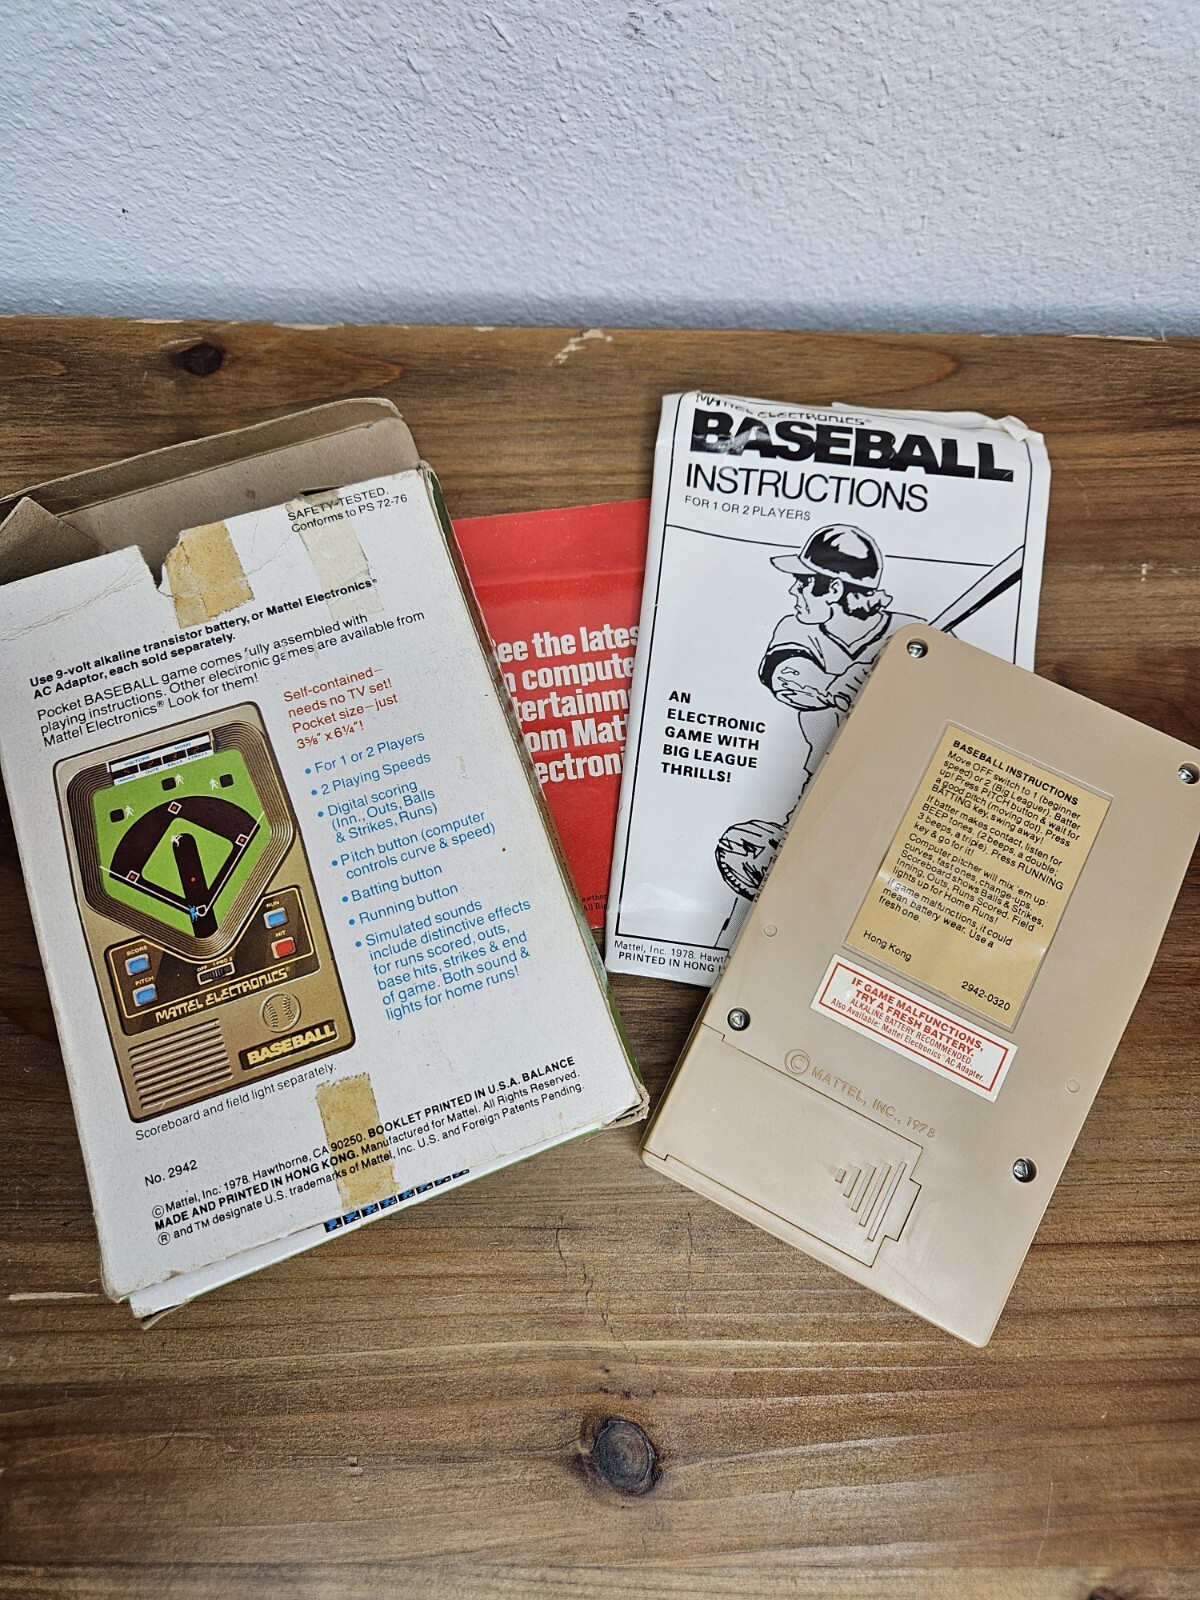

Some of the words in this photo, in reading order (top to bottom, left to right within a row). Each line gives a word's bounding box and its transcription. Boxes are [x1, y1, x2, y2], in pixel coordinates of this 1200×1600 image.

[690, 407, 1014, 482] BASEBALL
[288, 488, 389, 521] SAFETY-TESTED.
[686, 462, 928, 512] INSTRUCTIONS
[291, 512, 344, 532] Conforms
[344, 509, 356, 518] to
[357, 502, 375, 514] PS
[376, 493, 408, 509] 72-76
[684, 495, 709, 508] FOR
[713, 501, 718, 510] 1
[721, 502, 740, 513] OR
[742, 505, 750, 515] 2
[752, 505, 811, 521] PLAYERS
[29, 674, 53, 687] Use
[55, 661, 92, 679] 9-volt
[93, 647, 141, 667] alkaline
[142, 629, 202, 652] transistor
[204, 616, 250, 634] battery,
[251, 611, 263, 620] or
[266, 599, 303, 616] Mattel
[493, 639, 528, 663] ee
[532, 631, 577, 658] the
[33, 685, 52, 699] AC
[55, 671, 107, 693] Adaptor,
[109, 660, 139, 676] each
[141, 650, 168, 666] sold
[170, 633, 236, 657] separately.
[36, 698, 82, 721] Pocket
[83, 675, 159, 706] BASEBALL
[161, 665, 197, 685] game
[200, 652, 242, 671] comes
[342, 613, 368, 628] with
[43, 725, 83, 747] Mattel
[167, 690, 200, 708] Look
[201, 685, 219, 698] for
[221, 672, 258, 692] them!
[288, 699, 327, 718] needs
[329, 694, 346, 706] no
[346, 685, 365, 699] TV
[368, 677, 392, 694] set!
[512, 688, 631, 722] tertainm
[668, 690, 691, 704] AN
[292, 712, 337, 733] Pocket
[664, 725, 713, 743] GAME
[717, 734, 759, 750] WITH
[667, 707, 766, 733] ELECTRONIC
[314, 759, 336, 773] For
[340, 755, 346, 765] 1
[350, 751, 363, 762] or
[365, 746, 375, 758] 2
[376, 732, 425, 754] Players
[535, 746, 626, 784] ectron
[660, 761, 731, 783] THRILLS!
[662, 743, 689, 758] BIG
[693, 748, 758, 768] LEAGUE
[320, 783, 330, 795] 2
[332, 769, 380, 791] Playing
[382, 753, 431, 775] Speeds
[947, 750, 971, 767] Move
[972, 762, 994, 776] OFF
[992, 773, 1020, 791] switch
[1021, 786, 1031, 796] to
[1038, 794, 1081, 820] (beginner
[952, 740, 1003, 770] BASEBALL
[1005, 765, 1078, 805] INSTRUCTIONS
[327, 794, 368, 816] Digital
[370, 781, 418, 803] scoring
[917, 812, 925, 820] 3
[924, 814, 953, 836] beeps,
[990, 848, 1016, 867] Press
[1016, 859, 1064, 891] RUNNING
[350, 879, 399, 902] Batting
[400, 865, 442, 886] button
[358, 899, 415, 924] Running
[415, 884, 458, 905] button
[365, 914, 432, 946] Simulated
[434, 901, 482, 923] sounds
[275, 930, 286, 938] HIT
[369, 938, 417, 961] include
[420, 916, 484, 944] distinctive
[487, 900, 531, 922] effects
[614, 940, 646, 953] Mattel,
[649, 945, 666, 955] Inc.
[671, 948, 696, 960] 1978.
[862, 929, 888, 950] Hong
[885, 942, 912, 962] Kong
[126, 945, 148, 957] SCORE
[618, 951, 666, 965] PRINTED
[669, 958, 680, 967] IN
[683, 961, 715, 972] HONG
[135, 975, 154, 986] PITCH
[385, 1000, 422, 1020] lights
[424, 993, 442, 1007] for
[444, 980, 483, 1000] home
[485, 964, 519, 986] runs!
[960, 980, 1010, 1011] 2942-0320
[155, 998, 203, 1023] MATTEL
[851, 977, 863, 986] IF
[863, 983, 895, 1004] GAME
[895, 999, 983, 1052] MALFUNCTIONS,
[855, 989, 877, 1004] TRY
[876, 1001, 884, 1010] A
[886, 1005, 922, 1029] FRESH
[923, 1024, 974, 1057] BATTERY.
[247, 1024, 336, 1065] BASEBALL
[849, 998, 884, 1020] ALKALINE
[884, 1015, 915, 1035] BATTERY
[915, 1031, 972, 1066] RECOMMENDED.
[135, 1109, 200, 1141] Scoreboard
[202, 1101, 224, 1117] and
[225, 1092, 250, 1108] field
[250, 1083, 275, 1100] light
[276, 1063, 336, 1090] separately.
[252, 1154, 312, 1180] Hawthorne,
[312, 1145, 330, 1158] CA
[328, 1132, 366, 1152] 90250.
[367, 1110, 421, 1138] BOOKLET
[424, 1092, 472, 1118] PRINTED
[473, 1087, 486, 1099] IN
[487, 1077, 520, 1094] U.S.A.
[521, 1056, 575, 1082] BALANCE
[811, 1066, 867, 1107] MATTEL,
[906, 1116, 936, 1138] 1978
[144, 1174, 165, 1187] No.
[167, 1159, 198, 1178] 2942
